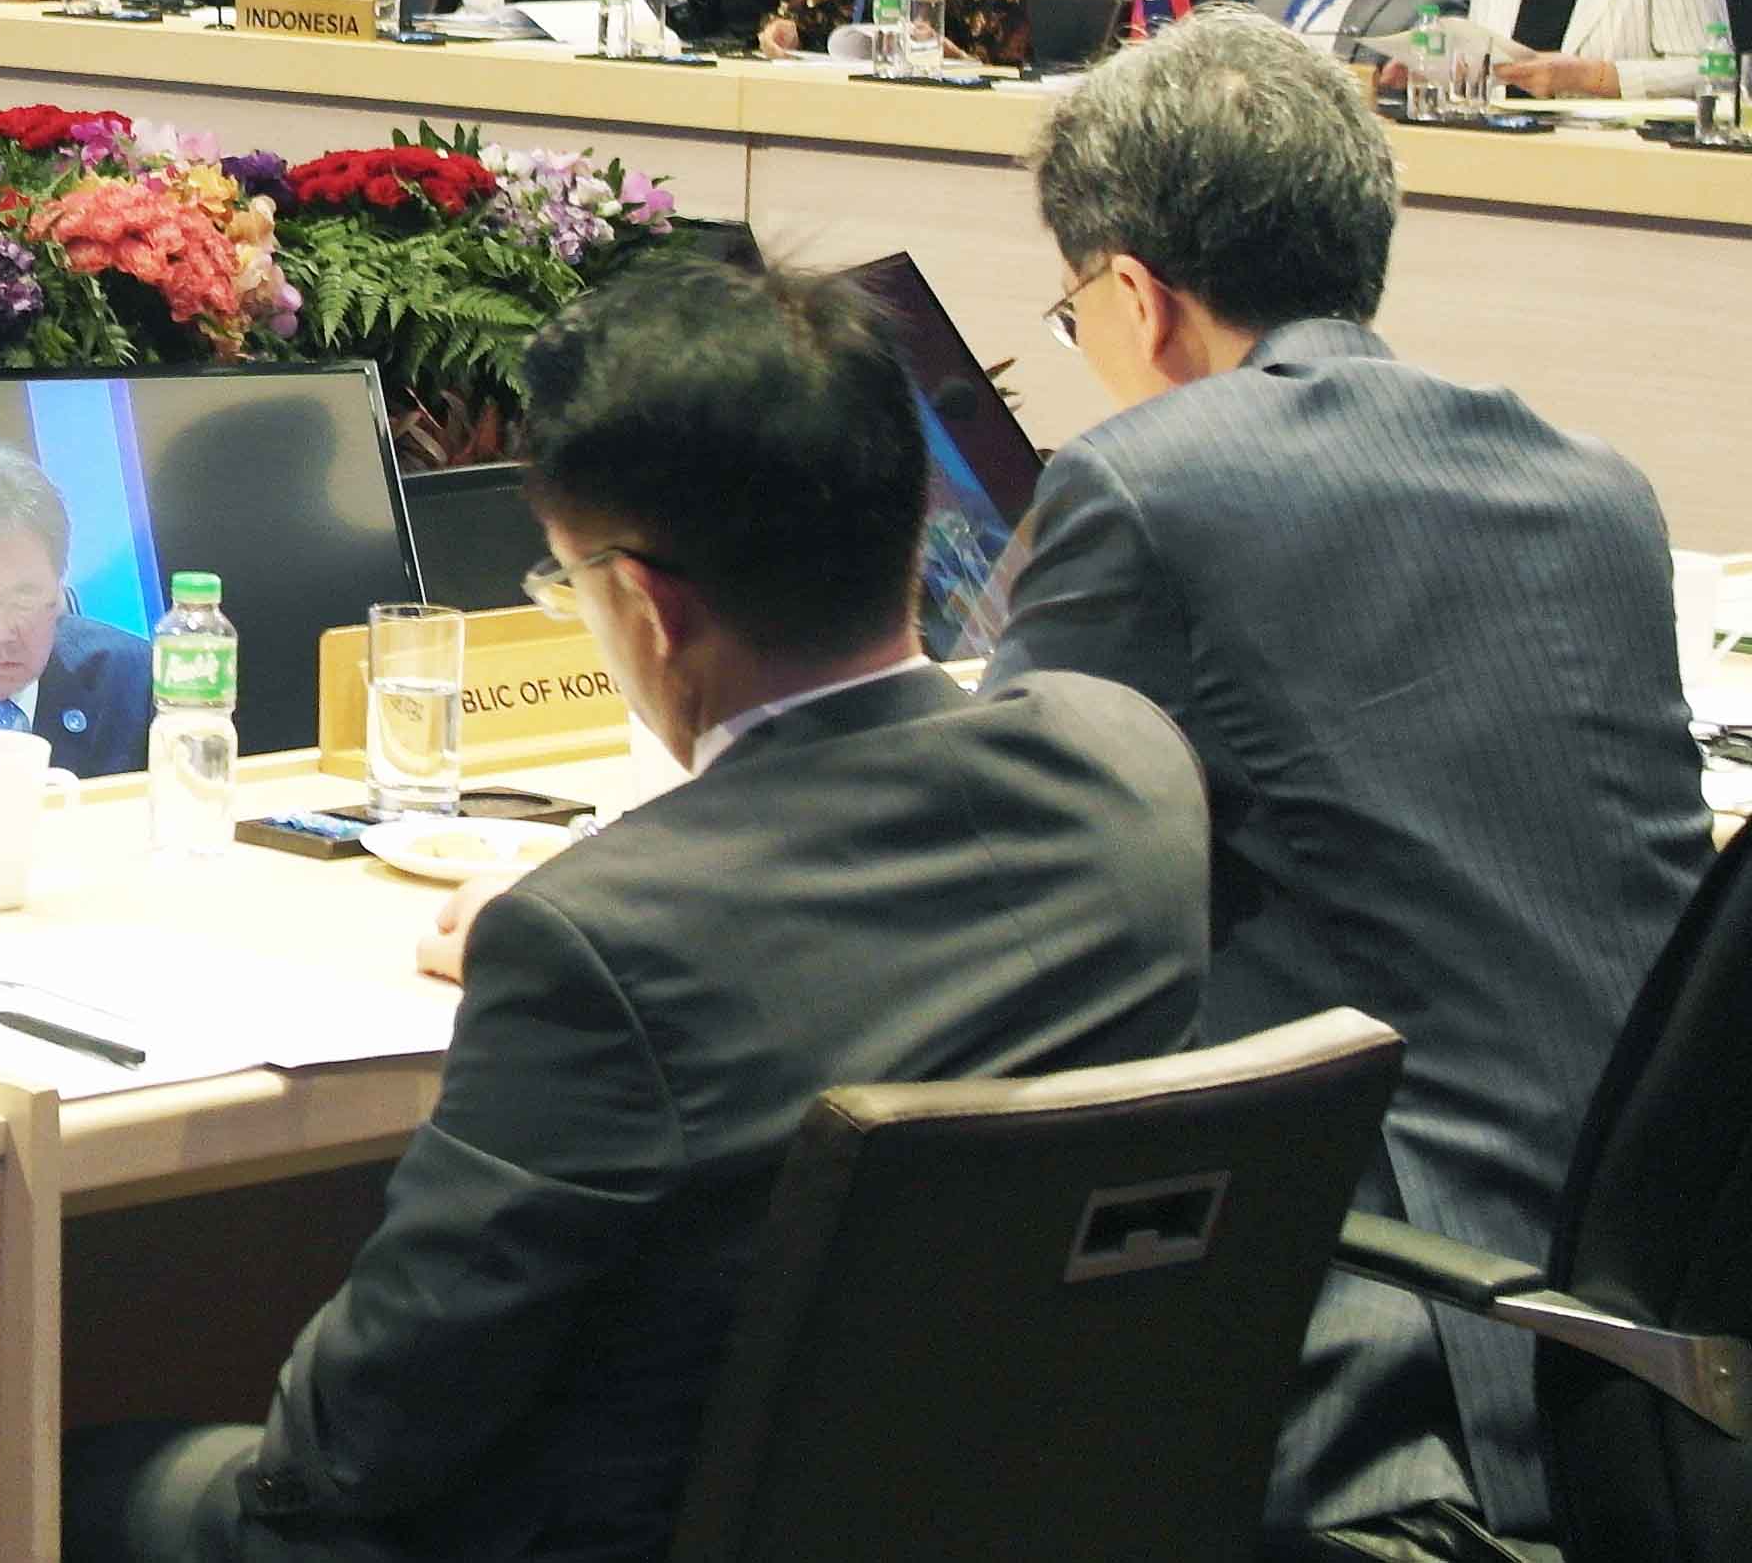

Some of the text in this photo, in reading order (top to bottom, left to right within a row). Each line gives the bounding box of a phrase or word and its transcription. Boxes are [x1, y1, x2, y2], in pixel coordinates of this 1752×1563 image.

[246, 5, 359, 37] INDONESIA
[461, 671, 621, 715] BLIC OF KOR
